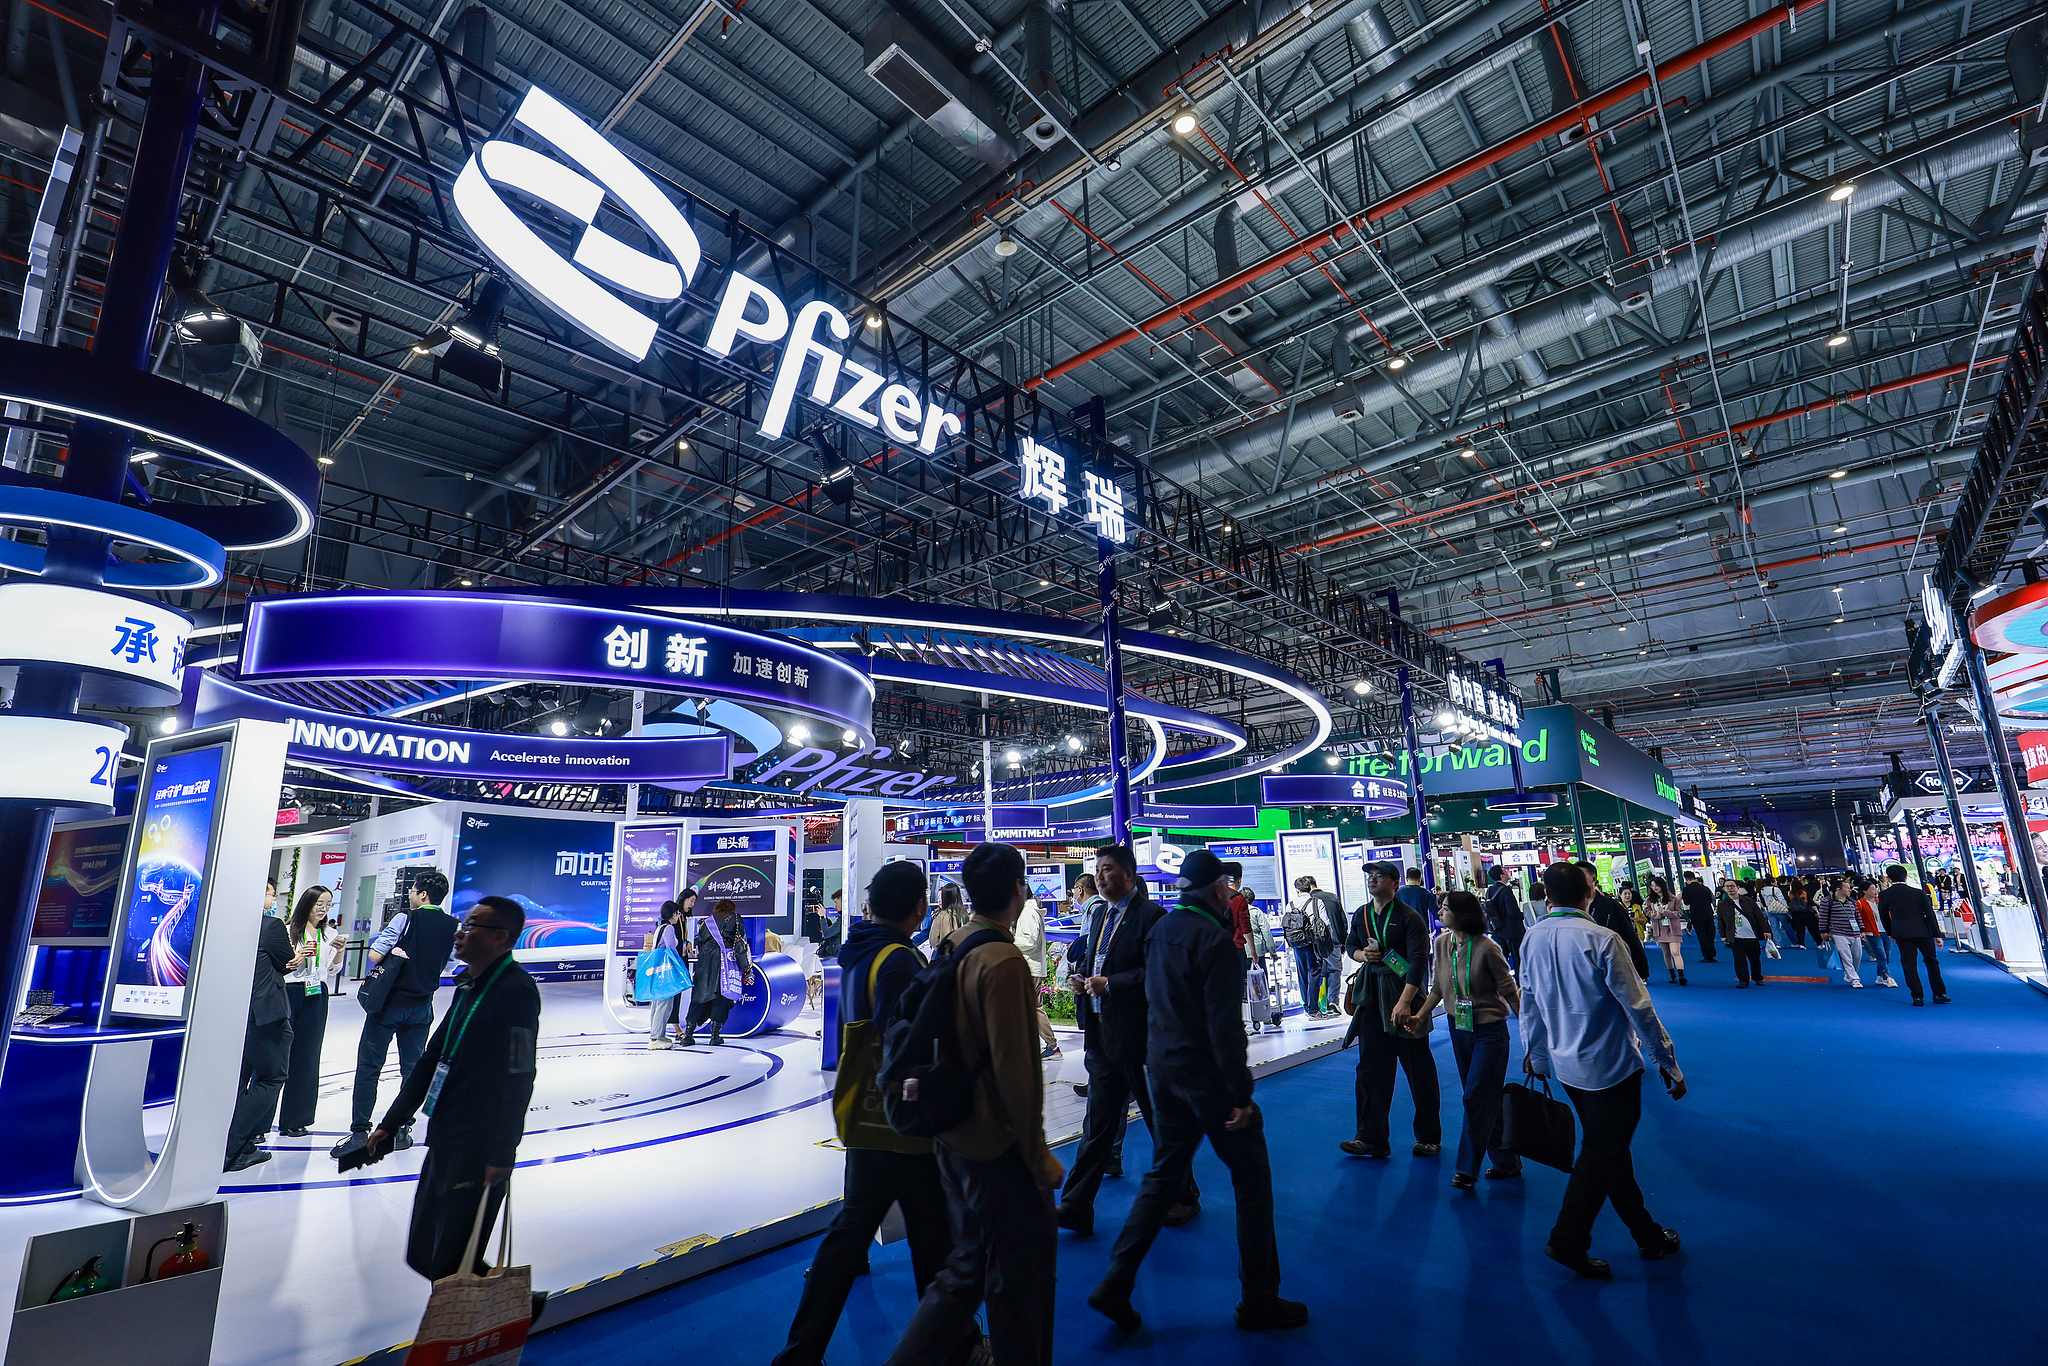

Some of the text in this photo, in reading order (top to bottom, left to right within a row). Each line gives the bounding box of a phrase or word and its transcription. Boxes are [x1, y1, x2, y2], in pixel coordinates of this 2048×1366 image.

[702, 269, 963, 456] Pfizer
[1017, 436, 1128, 545] 辉瑞
[603, 624, 810, 688] 创新 加速创新
[286, 718, 471, 764] INNOVATION
[490, 750, 630, 766] Accelerate innovation
[753, 746, 958, 796] Pfizer
[1351, 780, 1381, 799] 合作
[1925, 776, 1964, 788] Roe
[985, 827, 1057, 839] OMMITMENT
[1503, 830, 1527, 841] 创新
[716, 836, 750, 850] 偏头痛
[1224, 846, 1259, 855] 业务发展
[1511, 853, 1535, 862] 合作
